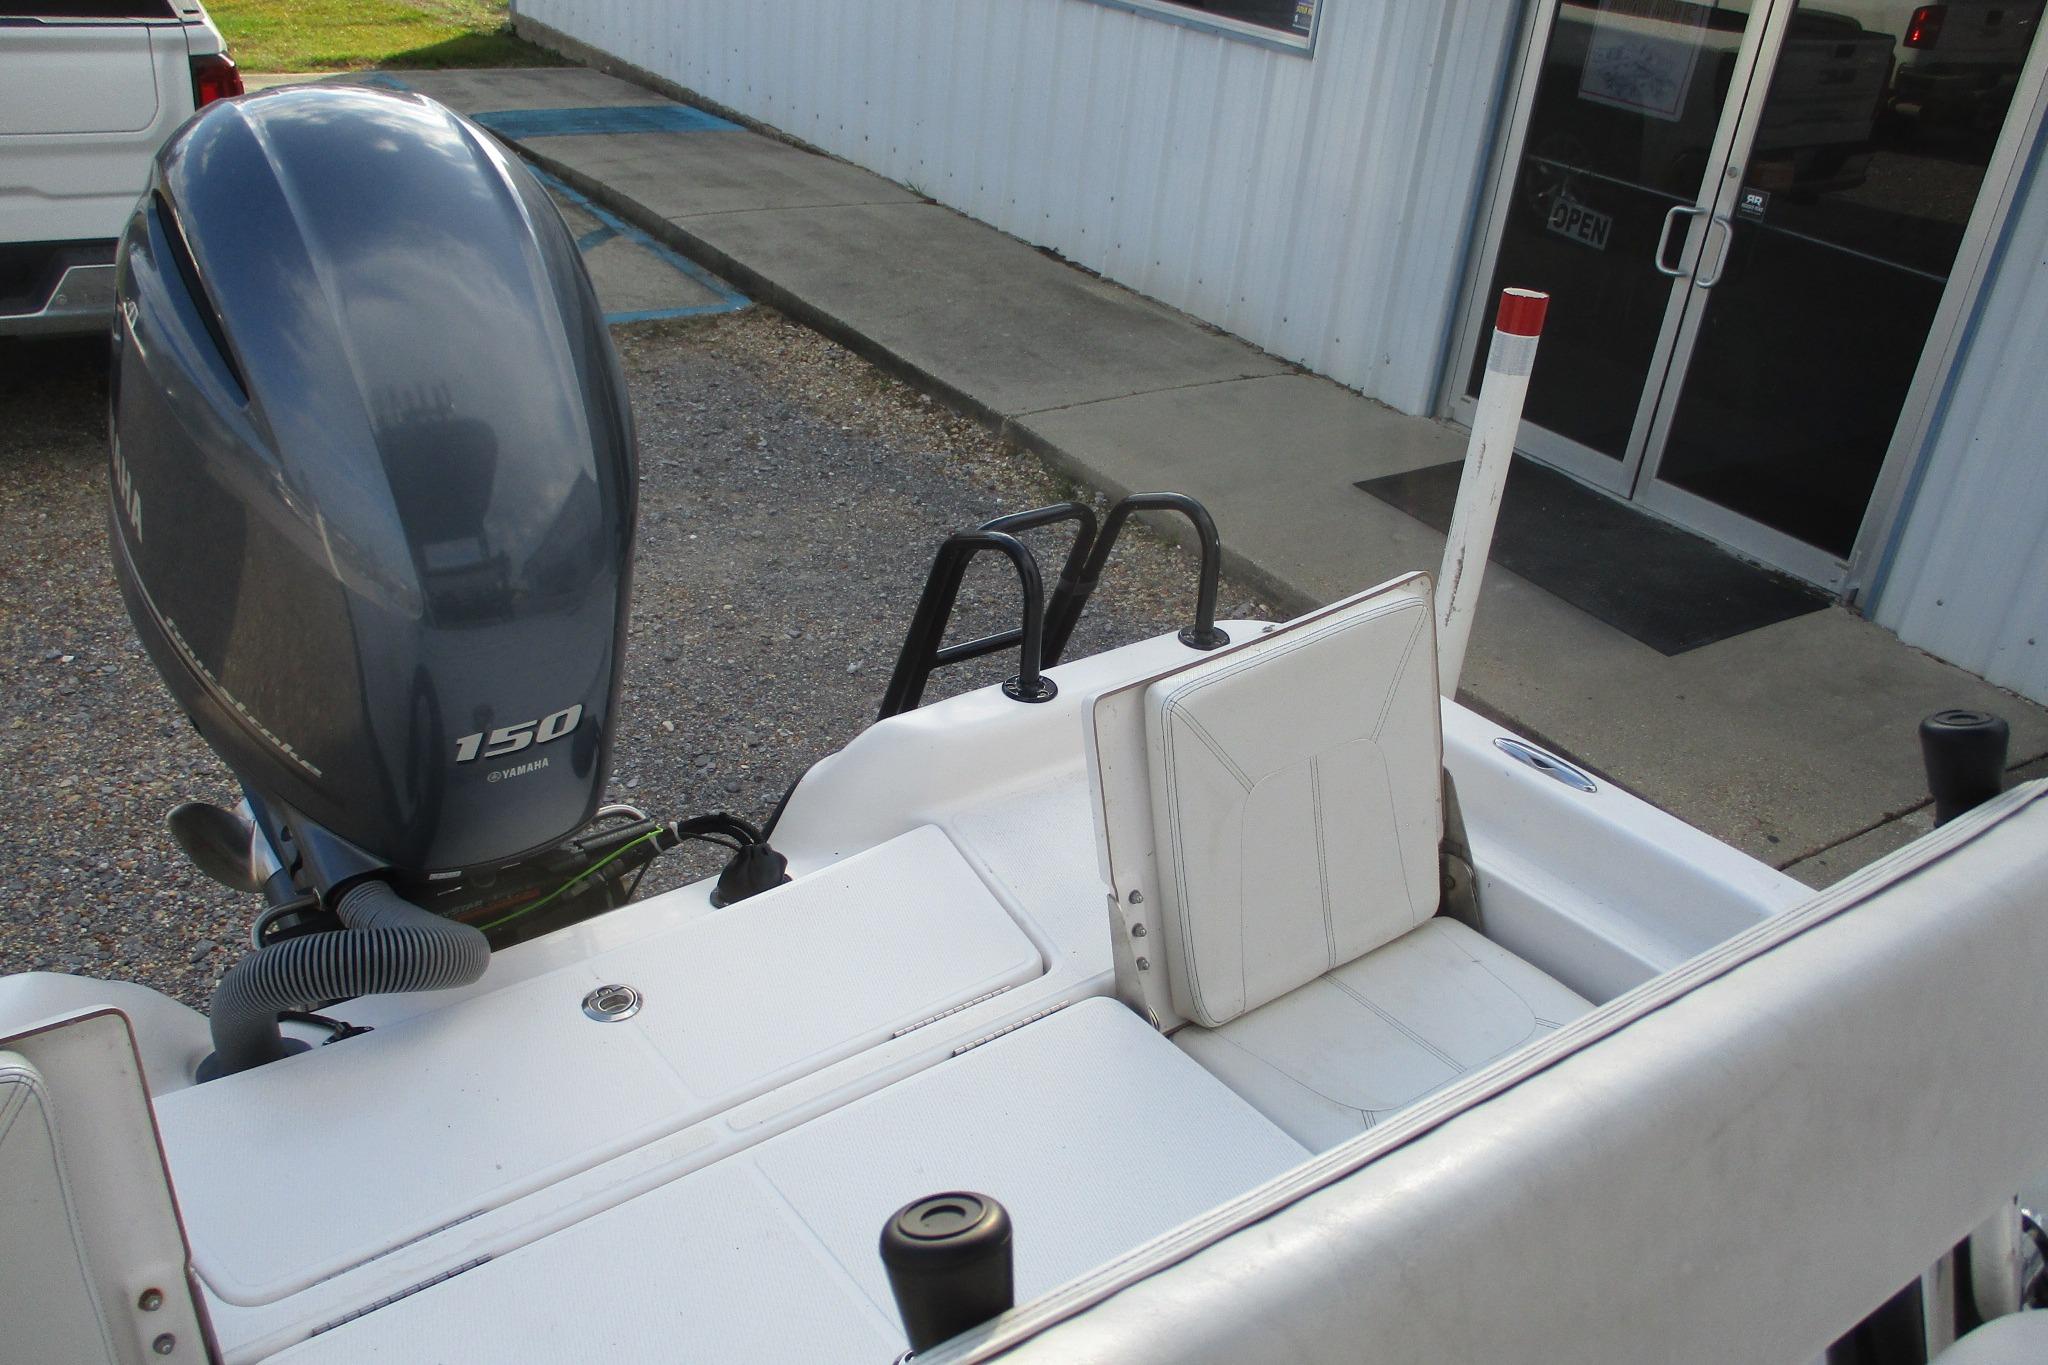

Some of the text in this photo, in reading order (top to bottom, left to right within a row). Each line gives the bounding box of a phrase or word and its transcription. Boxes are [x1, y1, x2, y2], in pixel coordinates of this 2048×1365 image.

[1552, 203, 1608, 245] OPEN
[456, 704, 583, 762] 150
[502, 757, 549, 779] YAMAHA
